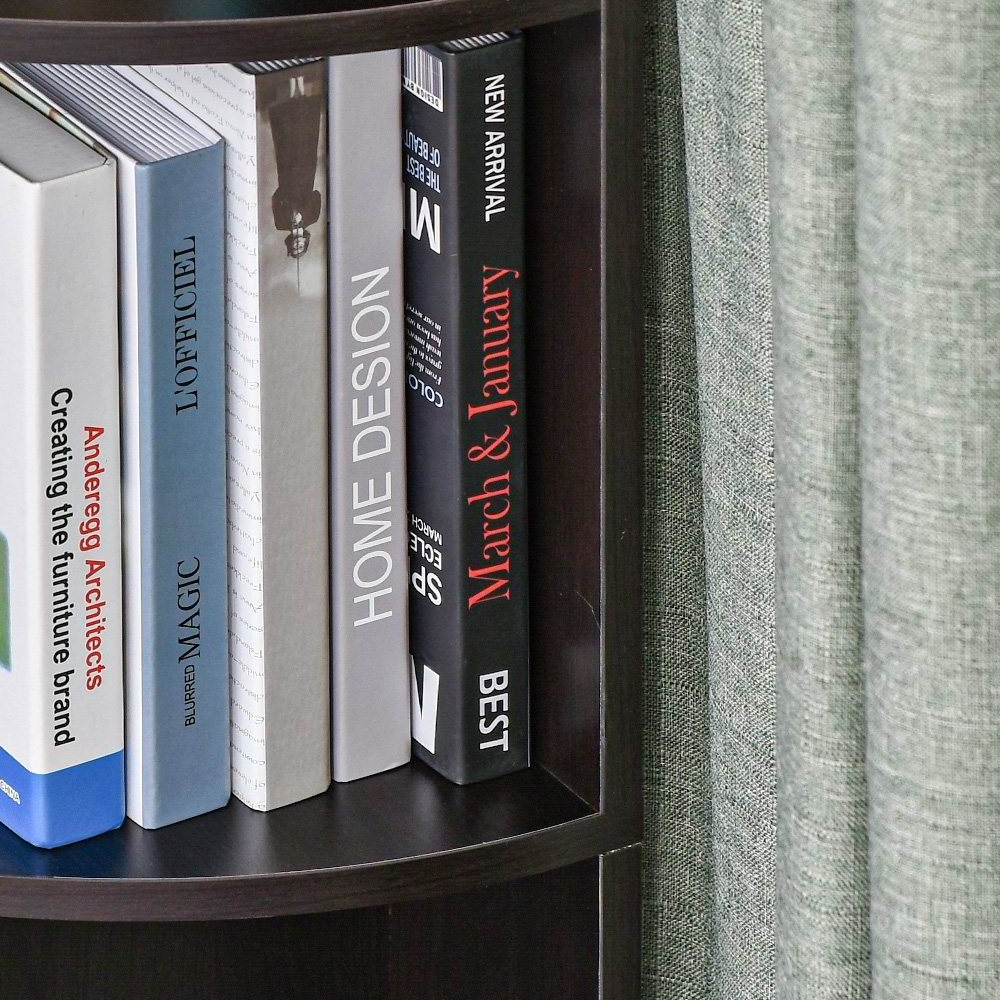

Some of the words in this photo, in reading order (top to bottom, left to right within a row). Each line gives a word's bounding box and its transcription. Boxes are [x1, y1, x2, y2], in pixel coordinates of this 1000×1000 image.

[484, 73, 506, 123] NEW
[406, 156, 425, 183] BEST
[425, 167, 441, 194] THE
[429, 146, 441, 168] OF
[484, 130, 506, 222] ARRIVAL
[173, 235, 198, 416] L'OFFICIEL
[467, 265, 520, 420] January
[408, 373, 444, 408] COLO
[46, 387, 73, 499] Creating
[467, 424, 512, 462] &
[51, 503, 73, 547] the
[79, 426, 105, 552] Anderegg
[411, 513, 443, 545] MARCH
[353, 471, 393, 627] HOME
[467, 470, 512, 610] March
[52, 551, 74, 664] furniture
[85, 558, 107, 691] Architects
[177, 556, 201, 664] MAGIC
[53, 669, 75, 747] brand
[184, 664, 196, 727] BLURRED
[479, 669, 509, 752] BEST
